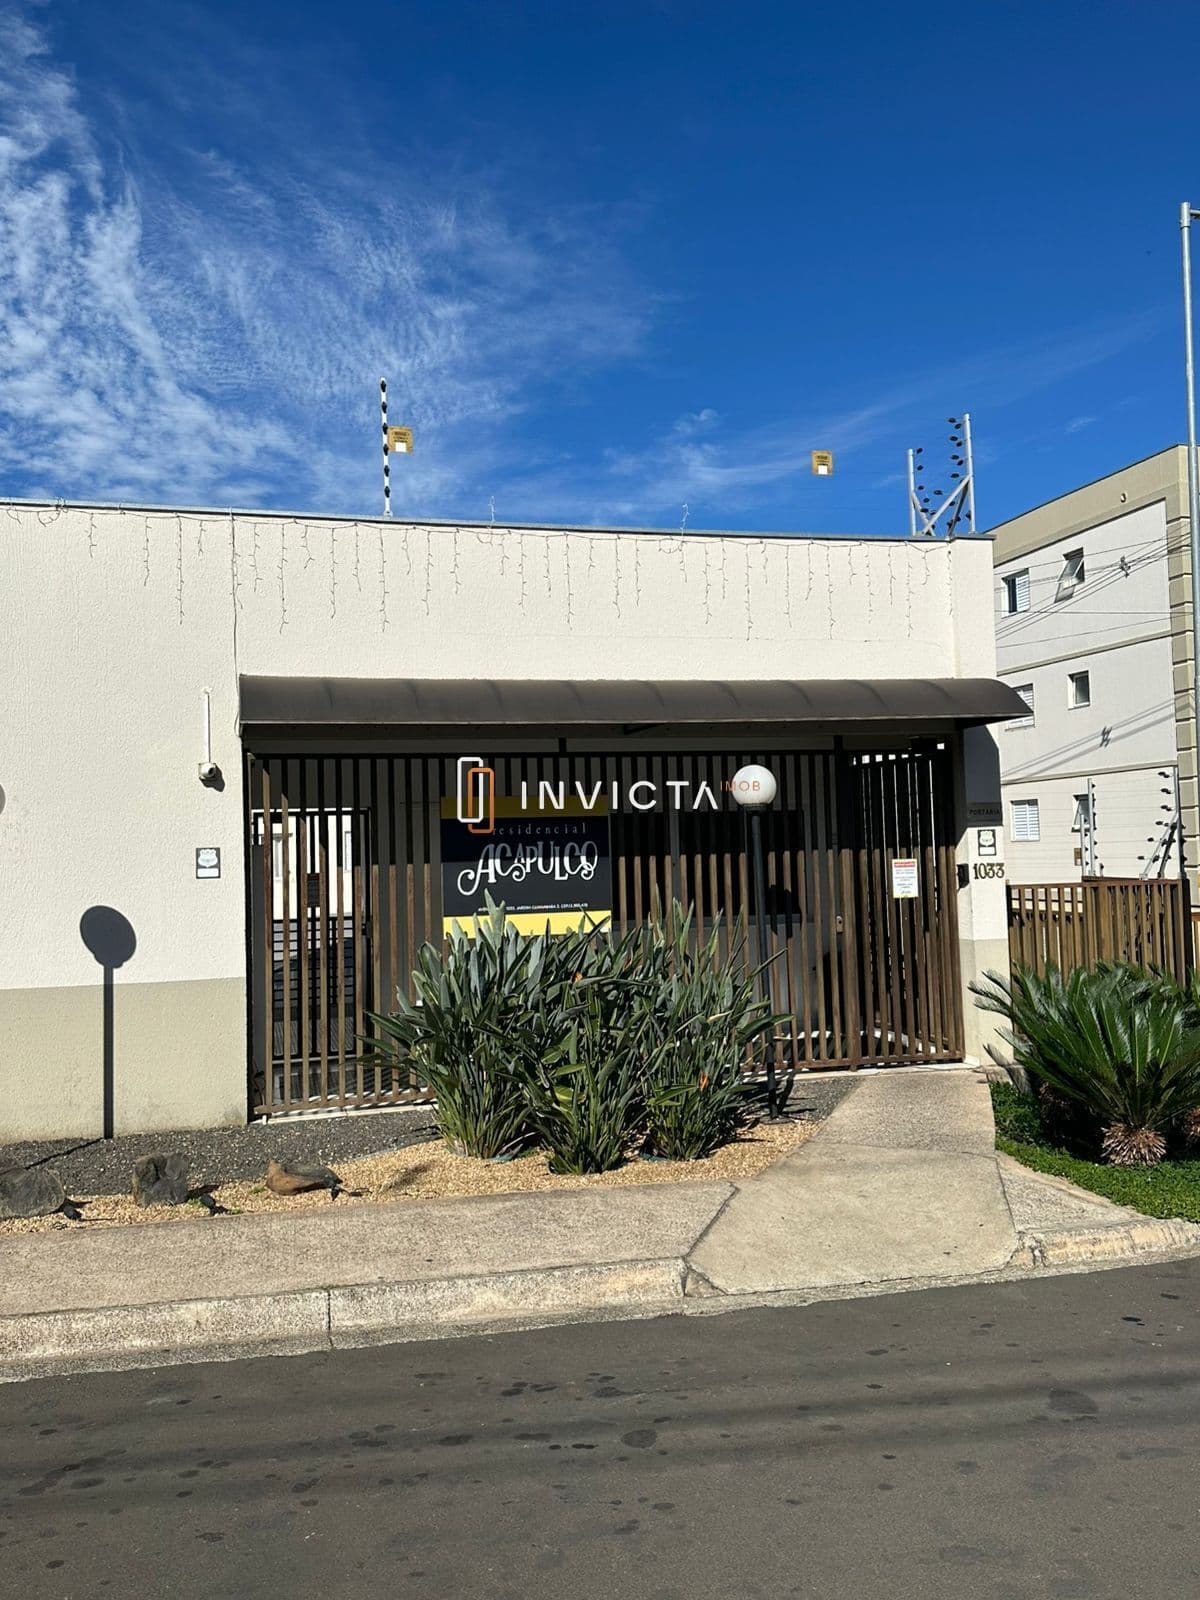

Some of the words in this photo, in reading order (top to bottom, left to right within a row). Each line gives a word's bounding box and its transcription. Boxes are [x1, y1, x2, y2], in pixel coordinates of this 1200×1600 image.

[492, 822, 587, 836] residencial
[457, 840, 599, 896] ACAPULCO
[973, 862, 1005, 879] 1033
